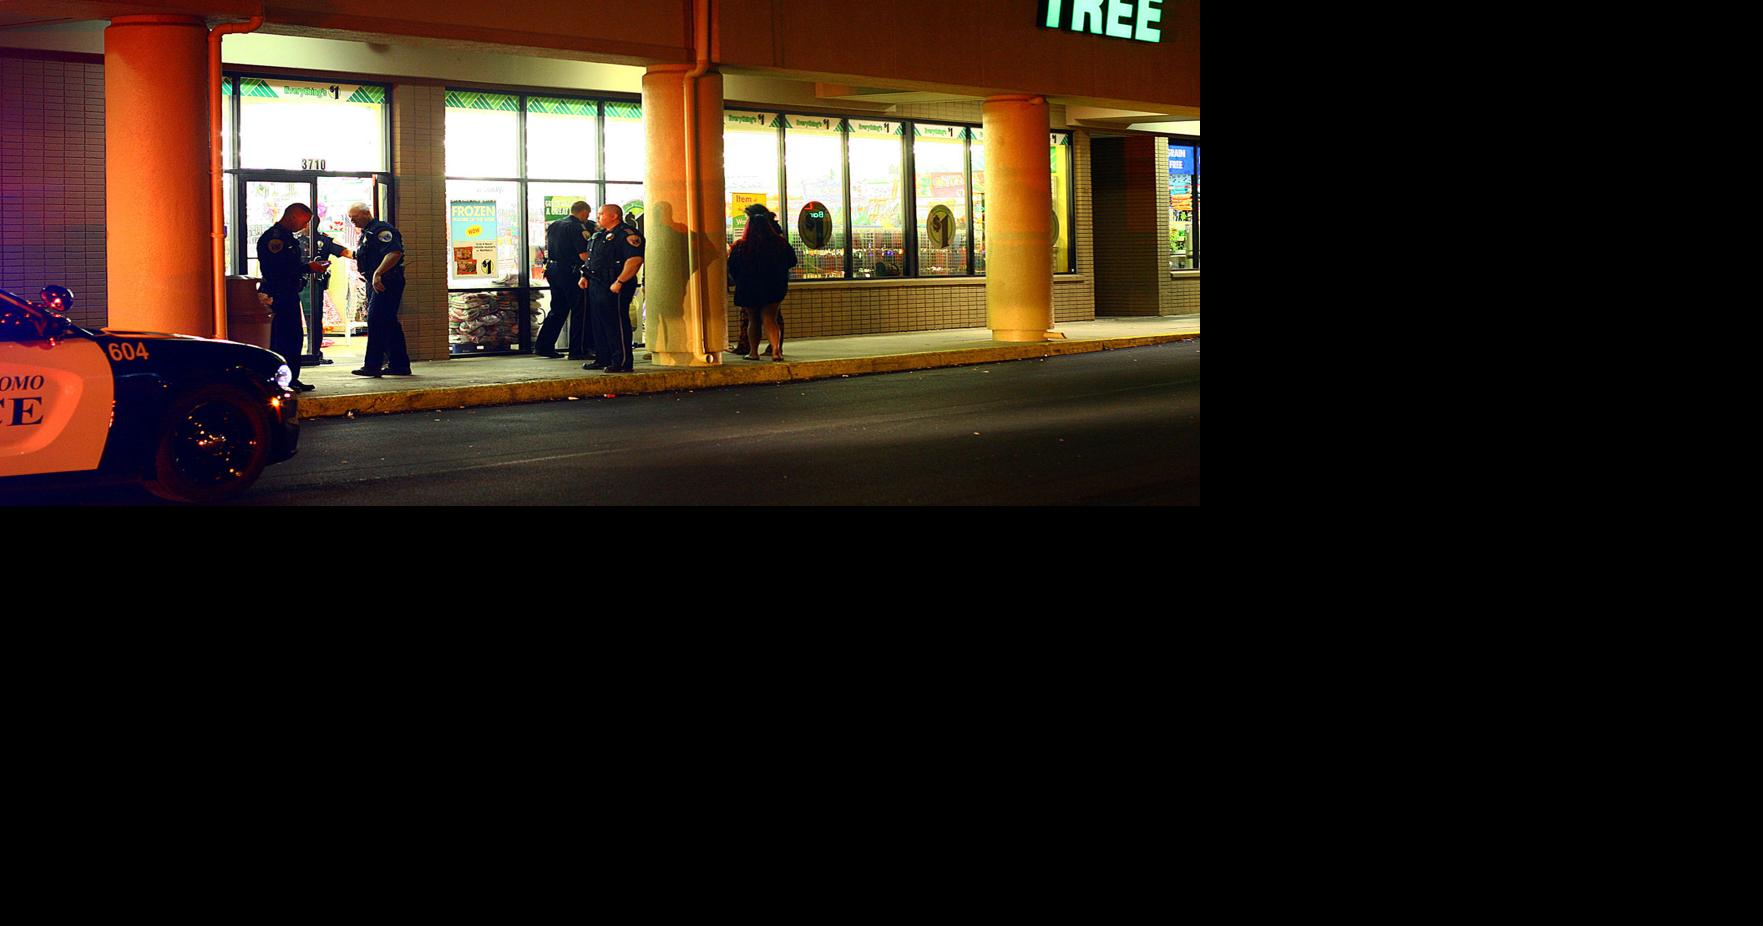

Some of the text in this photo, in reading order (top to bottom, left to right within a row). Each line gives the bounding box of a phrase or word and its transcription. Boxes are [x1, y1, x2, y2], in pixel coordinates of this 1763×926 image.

[1046, 0, 1163, 43] TREE
[302, 159, 326, 170] 3710
[1169, 160, 1183, 169] FREE
[736, 195, 752, 203] Item
[452, 205, 496, 217] FROZEN
[108, 342, 149, 361] 604
